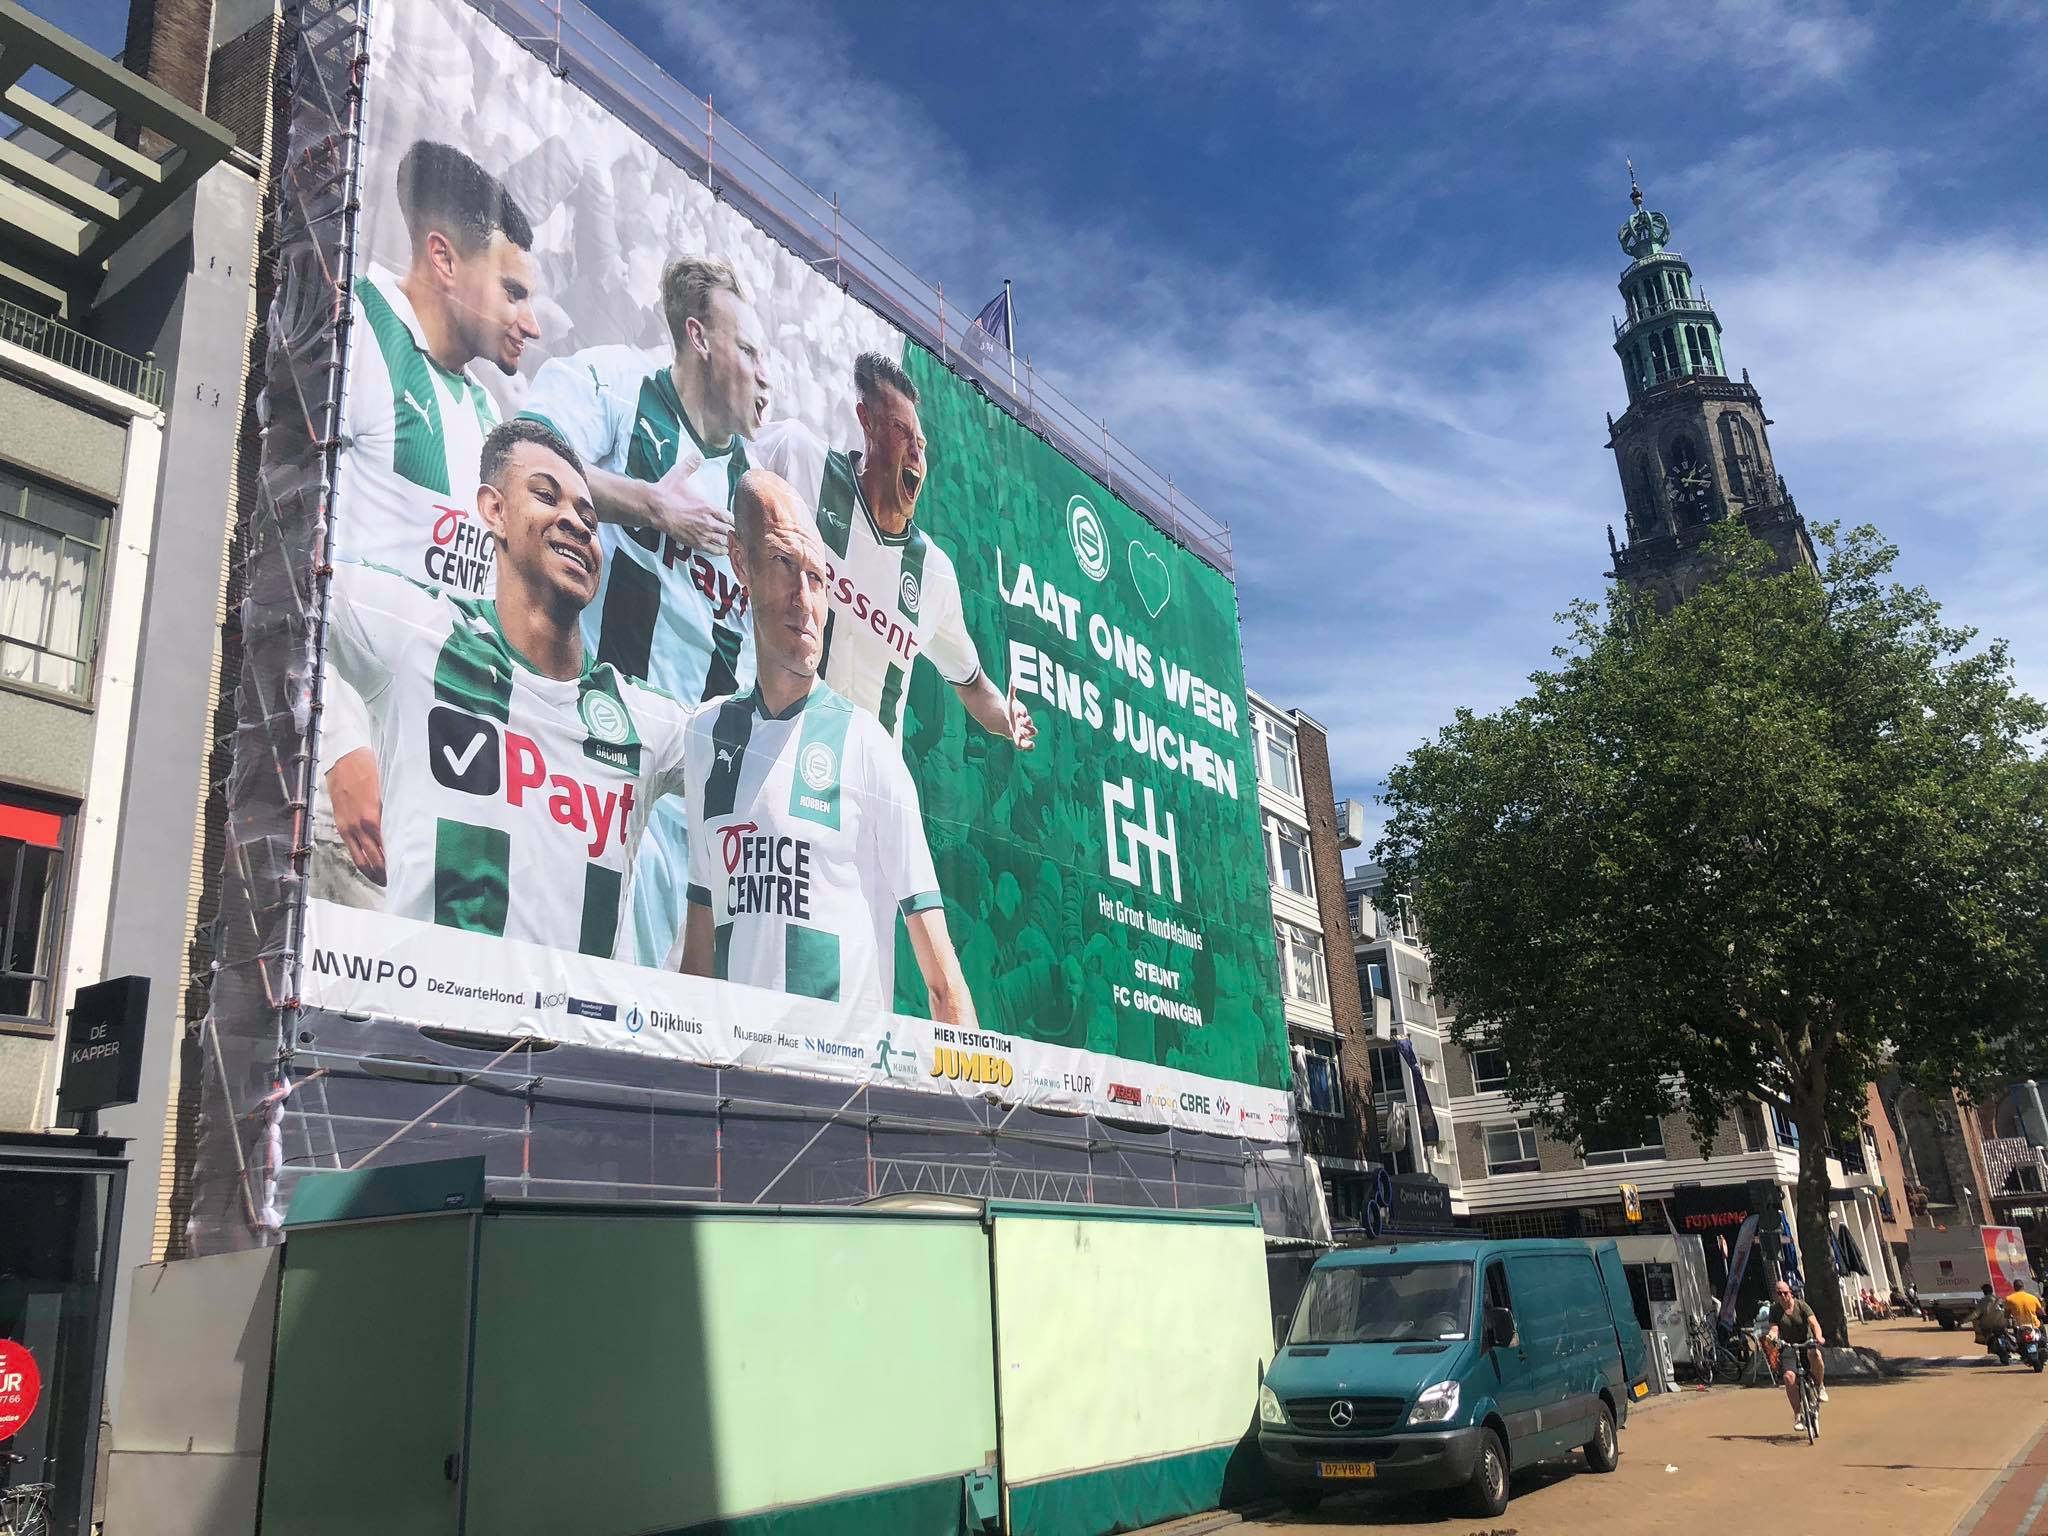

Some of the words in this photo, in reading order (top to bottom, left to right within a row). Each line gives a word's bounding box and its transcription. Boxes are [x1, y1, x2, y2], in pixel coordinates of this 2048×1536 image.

[432, 504, 497, 562] OFFIC
[996, 545, 1082, 642] LAAT
[1089, 613, 1155, 689] ONS
[1158, 655, 1240, 739] WEER
[1009, 638, 1104, 730] EENS
[1112, 697, 1239, 801] JUICHEN
[503, 729, 635, 858] Payt
[799, 795, 831, 814] ROBBEN
[716, 820, 811, 880] OFFICE
[727, 874, 811, 921] CENTRE
[1098, 892, 1115, 921] Het
[1116, 900, 1145, 931] Groot
[1146, 910, 1203, 951] Handelshuis
[311, 948, 418, 989] MWPO
[1134, 958, 1180, 991] STEUNT
[427, 977, 526, 1006] DeZwarteHond.
[1113, 984, 1131, 1007] FC
[1133, 990, 1203, 1028] GRONINGEN
[650, 1010, 703, 1036] Dijkhuis
[934, 1027, 955, 1043] HIER
[72, 1041, 120, 1064] KAPPER
[817, 1038, 865, 1060] Noorman
[930, 1044, 1014, 1088] JUMBO
[1180, 1092, 1211, 1115] CBRE
